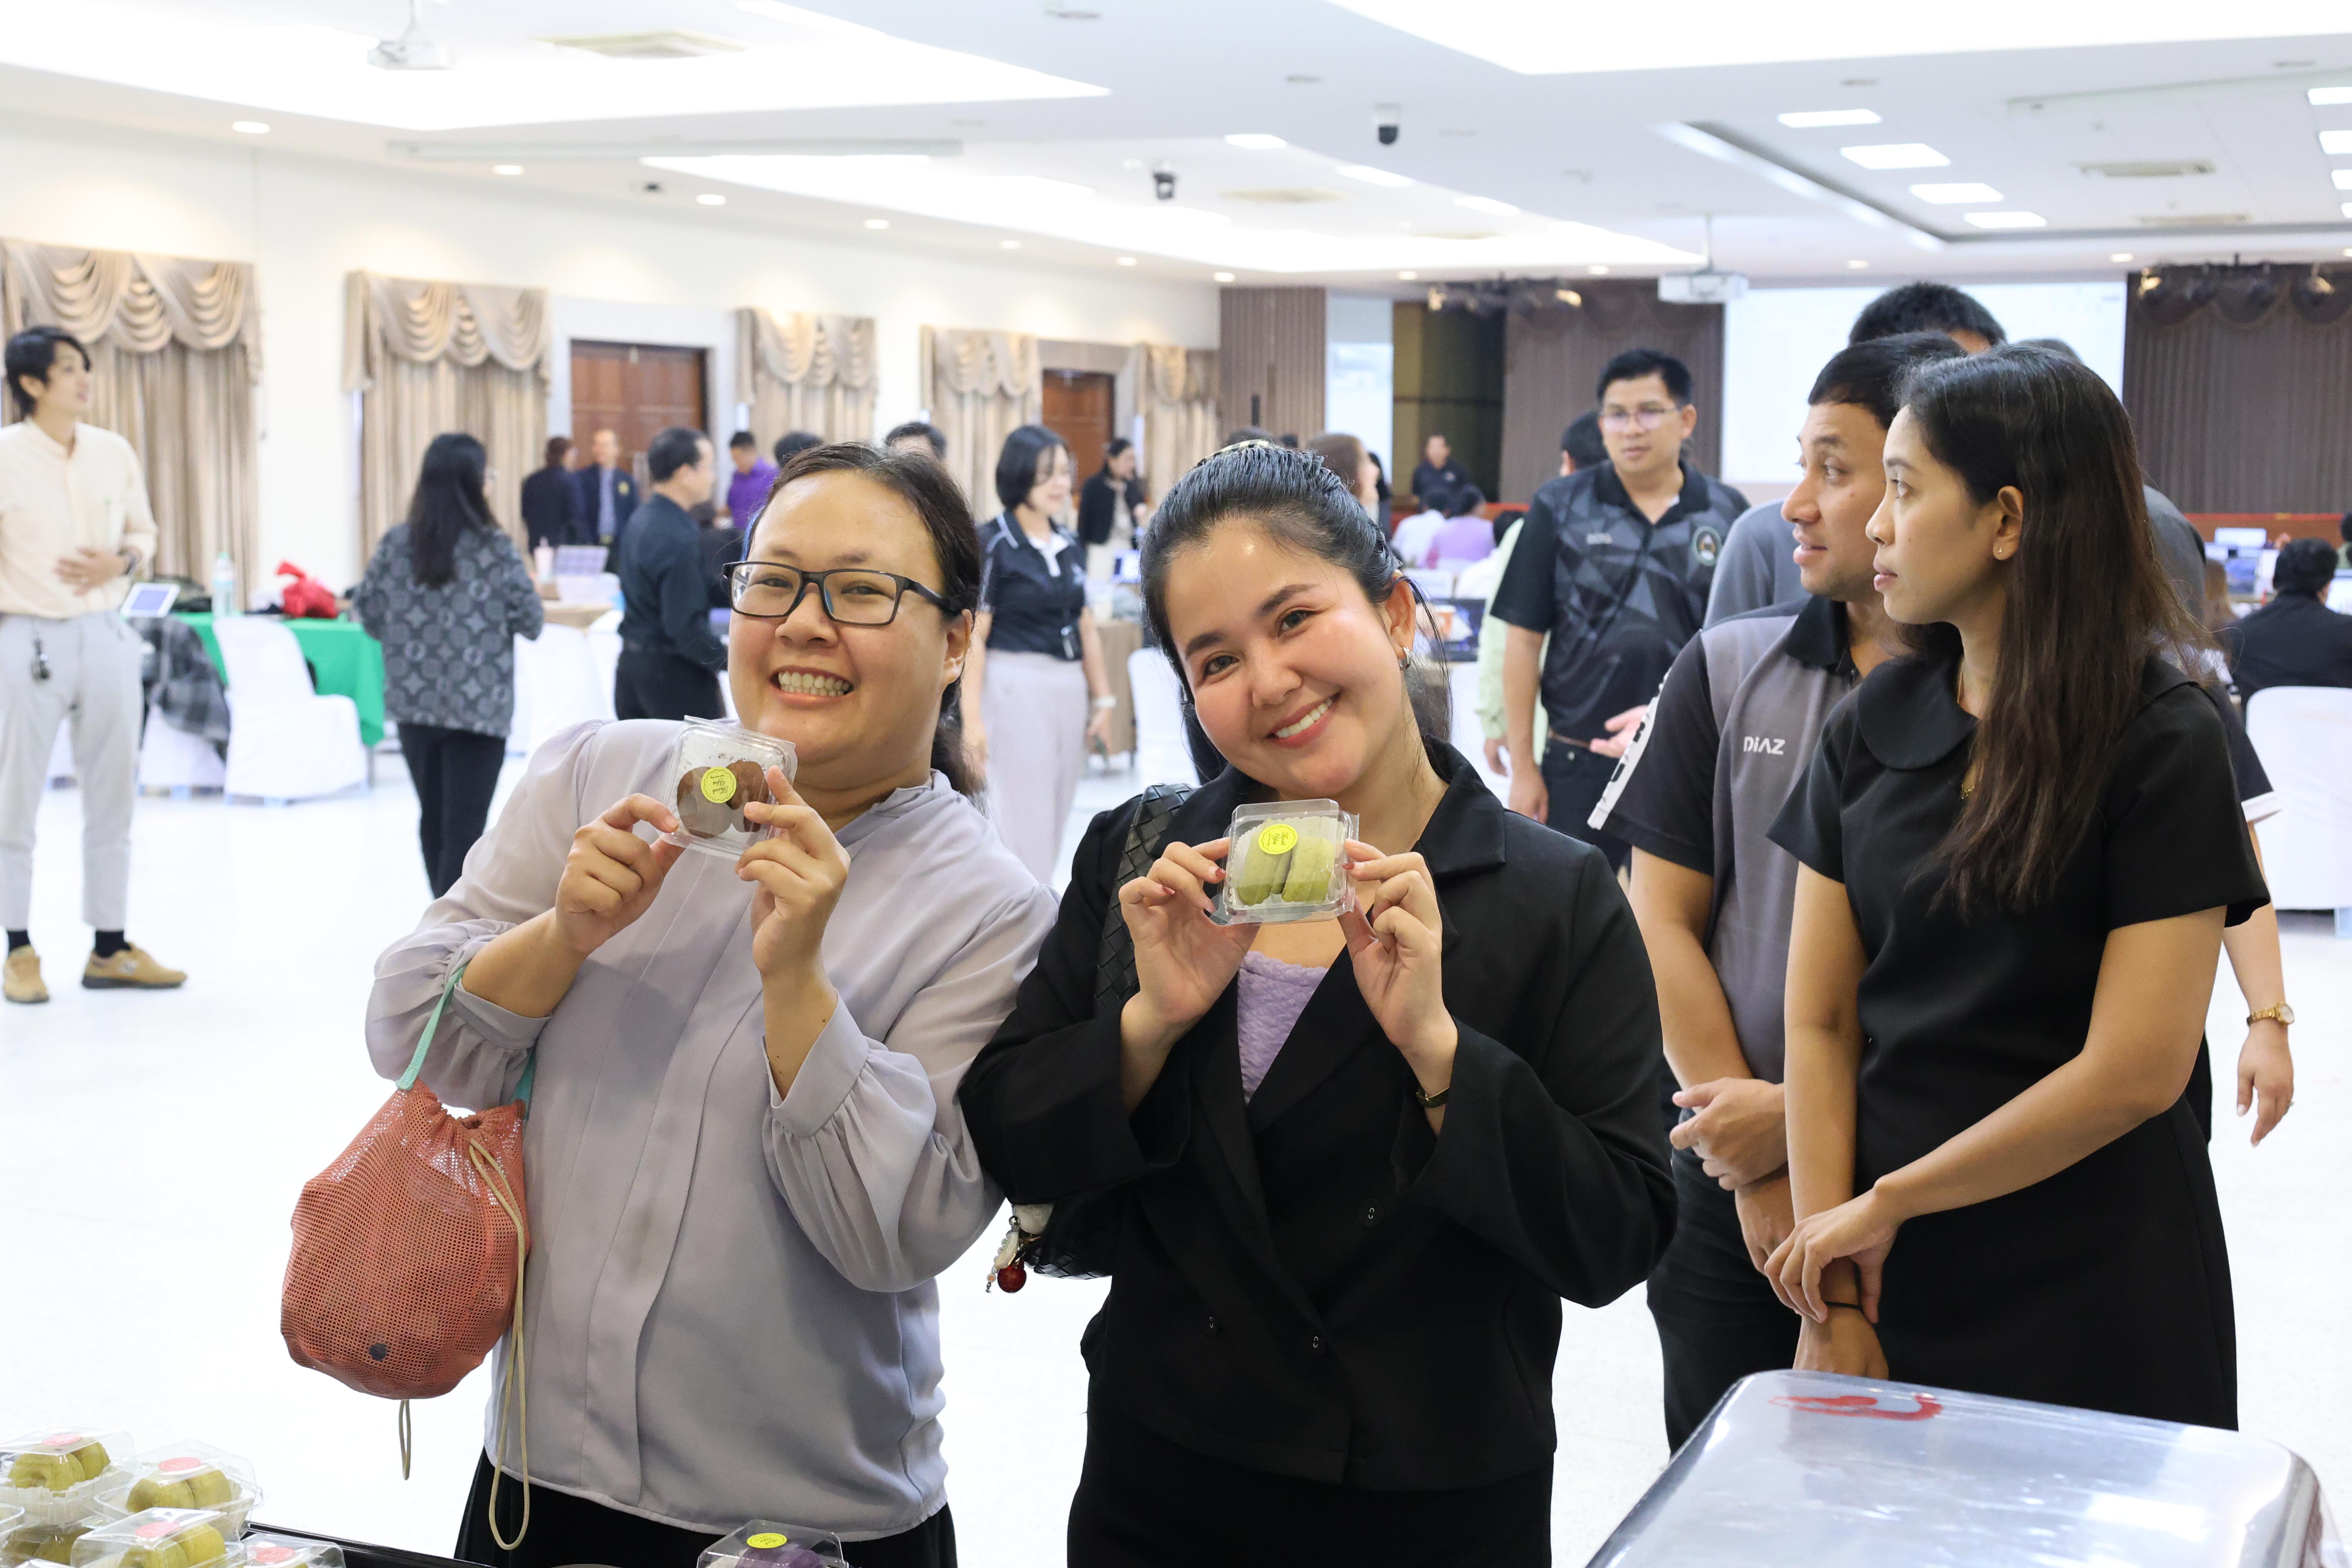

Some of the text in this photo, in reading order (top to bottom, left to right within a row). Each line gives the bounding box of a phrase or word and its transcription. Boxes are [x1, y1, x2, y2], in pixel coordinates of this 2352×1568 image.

[713, 778, 725, 787] You
[712, 786, 728, 795] Thank
[1272, 833, 1281, 845] You
